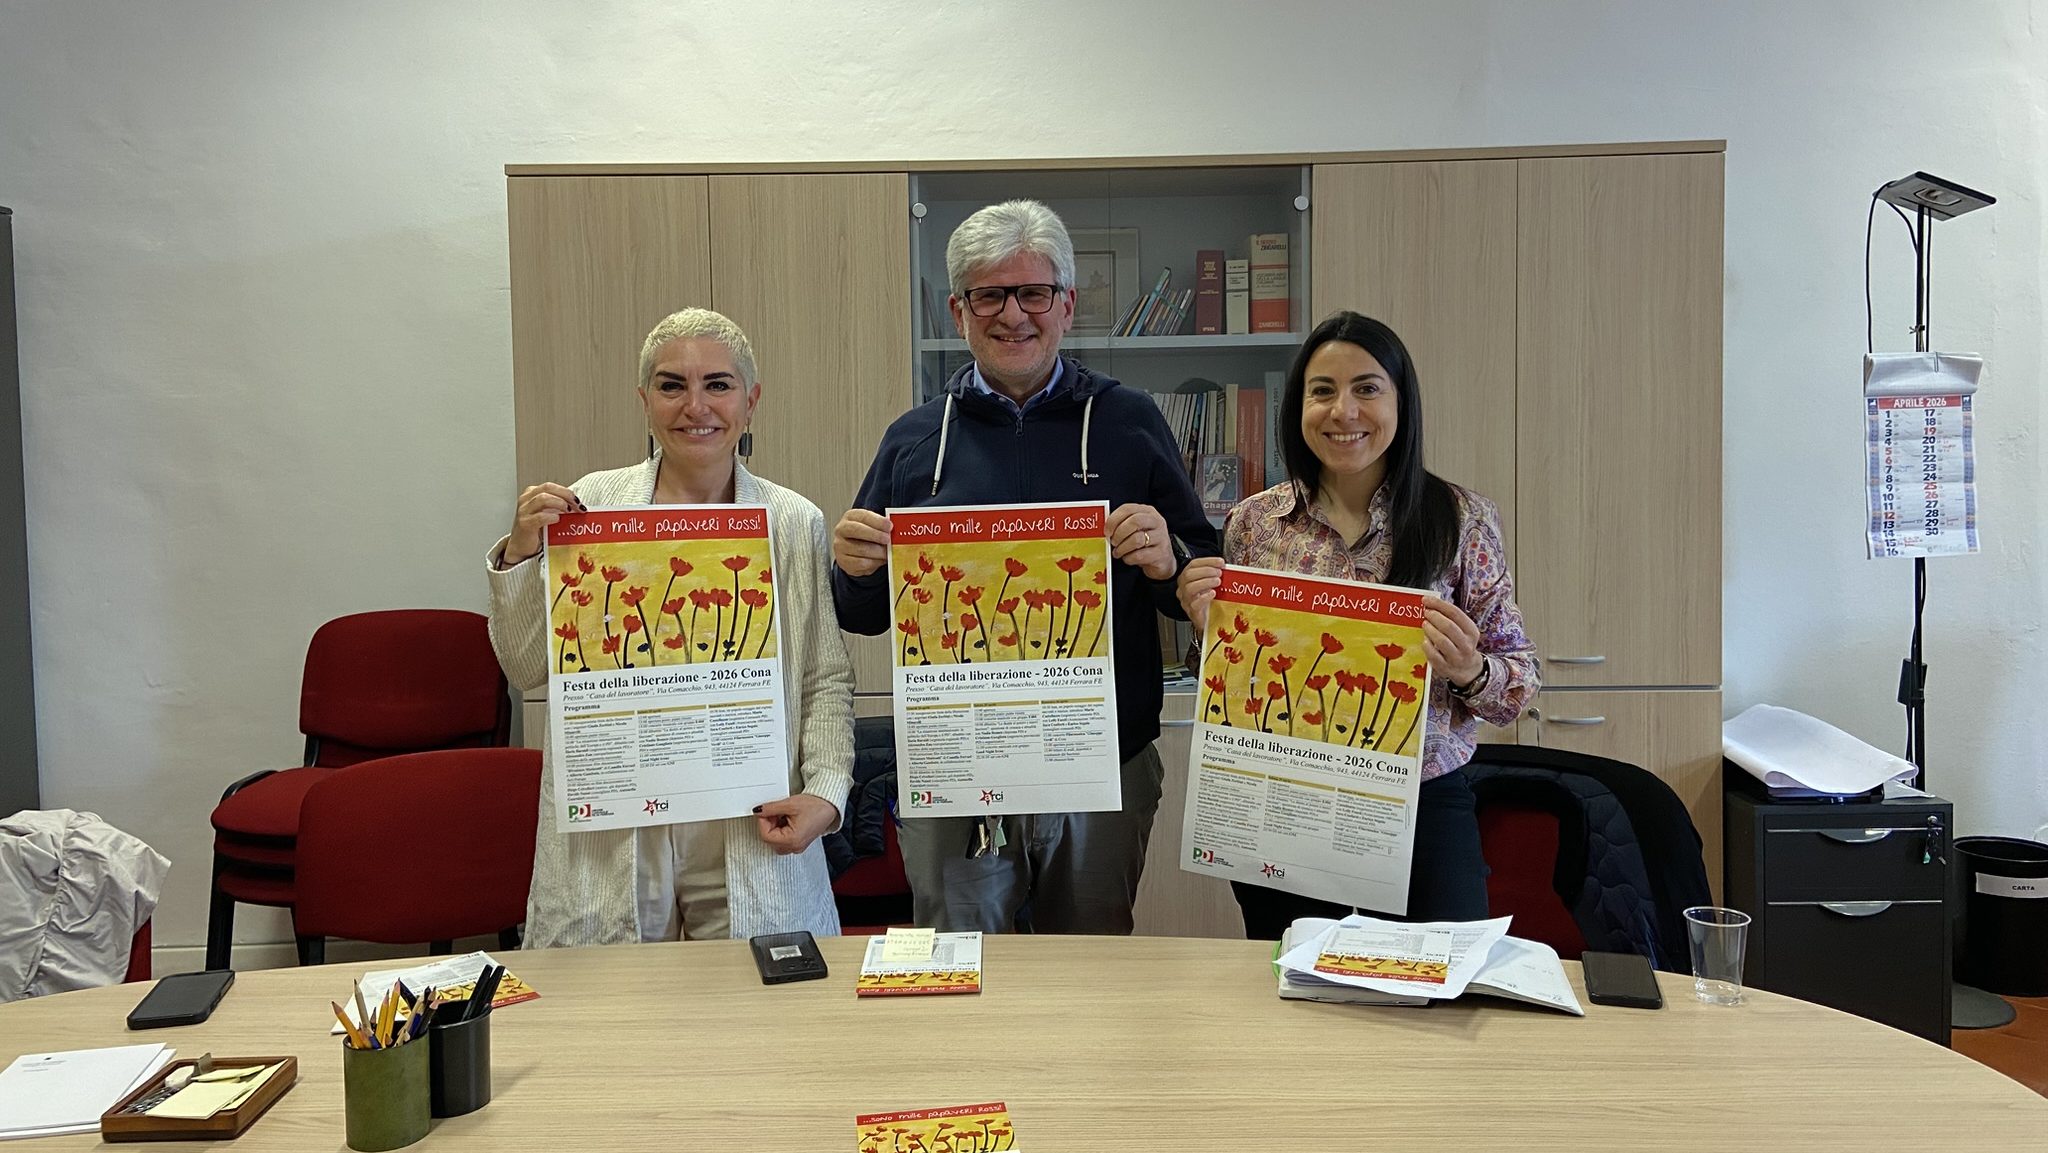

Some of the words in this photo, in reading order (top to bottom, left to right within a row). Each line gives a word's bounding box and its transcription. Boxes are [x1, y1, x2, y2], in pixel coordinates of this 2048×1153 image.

[1894, 398, 1924, 408] APRILE
[1926, 398, 1947, 407] 2026
[728, 515, 761, 530] Rossi!
[1064, 512, 1099, 530] Rossi!
[563, 680, 596, 692] Festa
[600, 677, 629, 690] della
[632, 672, 699, 687] liberazione
[710, 669, 738, 681] 2026
[741, 668, 772, 680] Cona
[906, 673, 936, 684] Festa
[938, 671, 966, 682] della
[970, 668, 1032, 681] liberazione
[1043, 667, 1070, 678] 2026
[1073, 665, 1103, 676] Cona
[563, 693, 584, 701] Presso
[604, 690, 616, 698] del
[657, 686, 667, 694] Via
[718, 681, 737, 690] 44124
[737, 680, 761, 688] Ferrara
[564, 704, 600, 712] Programma
[1203, 754, 1235, 764] Programma
[1205, 731, 1234, 745] Festa
[1238, 737, 1264, 750] della
[1268, 742, 1333, 762] liberazione
[1344, 755, 1372, 769] 2026
[1376, 761, 1408, 775] Cona
[1371, 774, 1396, 783] Ferrara
